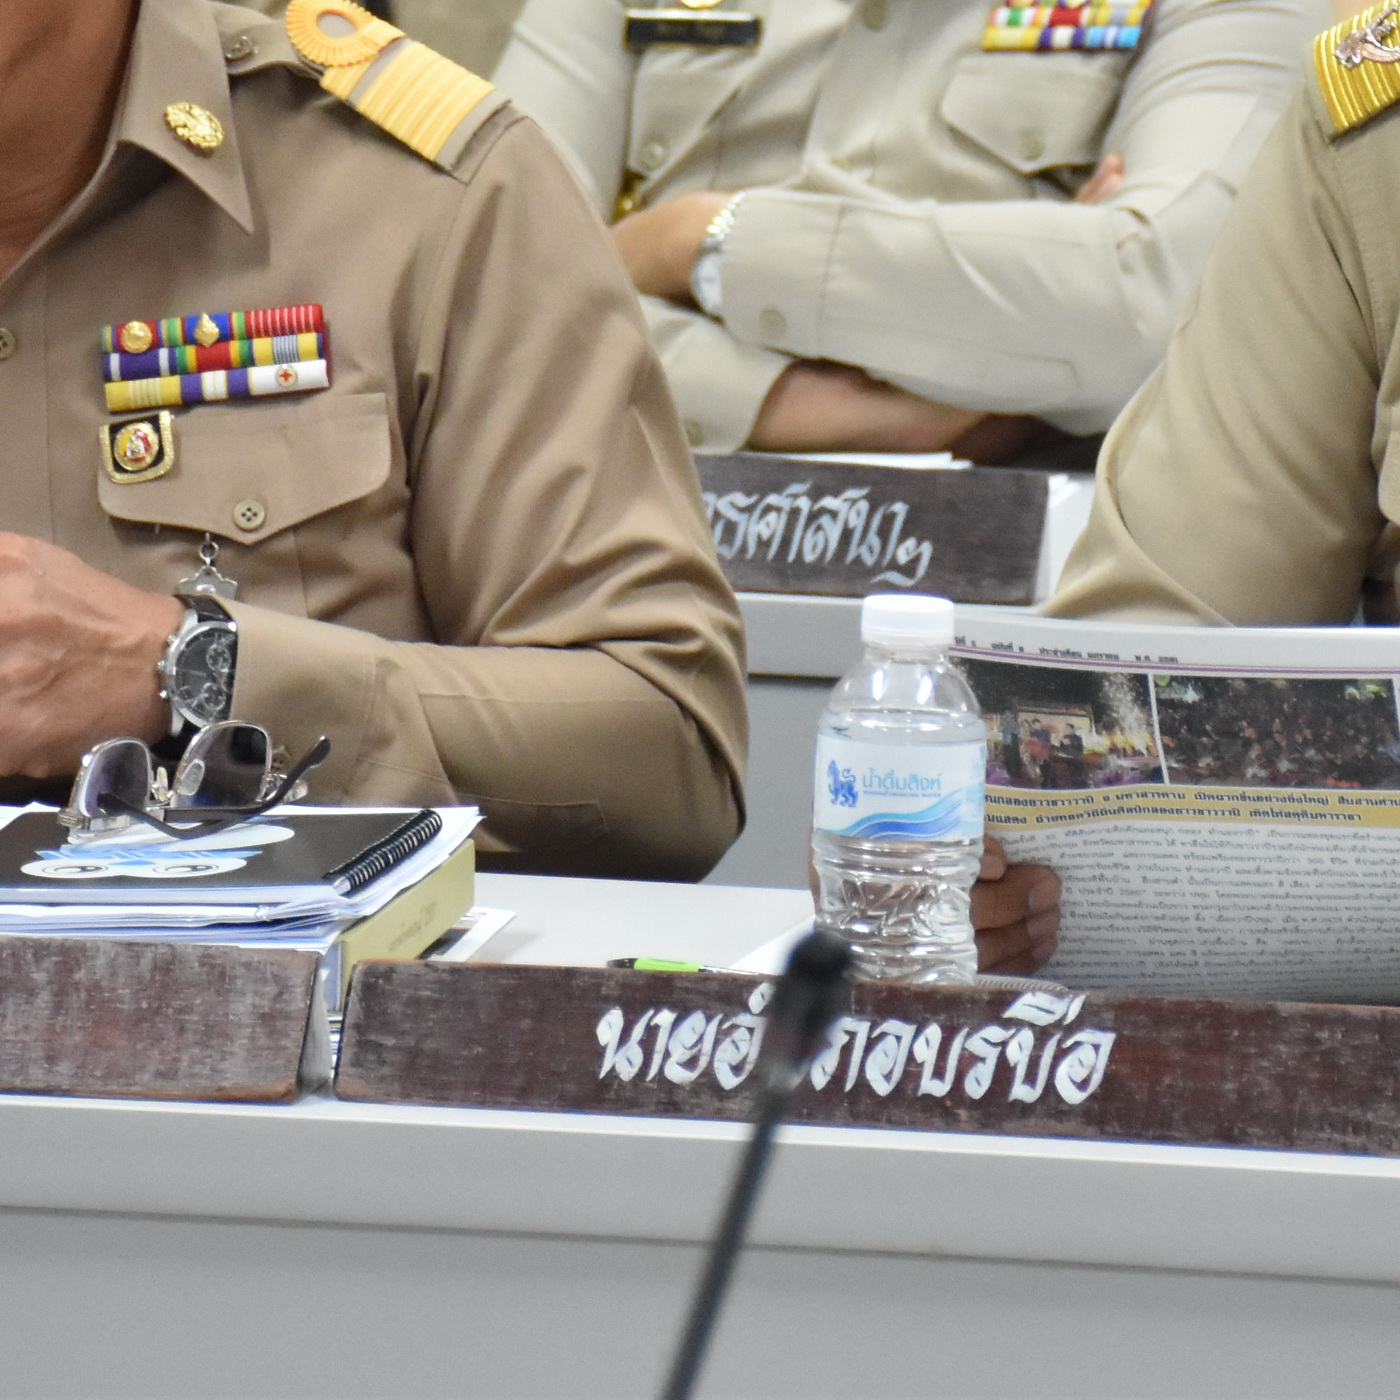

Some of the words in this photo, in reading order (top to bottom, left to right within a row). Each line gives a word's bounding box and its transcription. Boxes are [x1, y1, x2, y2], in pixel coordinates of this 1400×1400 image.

[596, 981, 1117, 1105] นายอภอบรบือ
